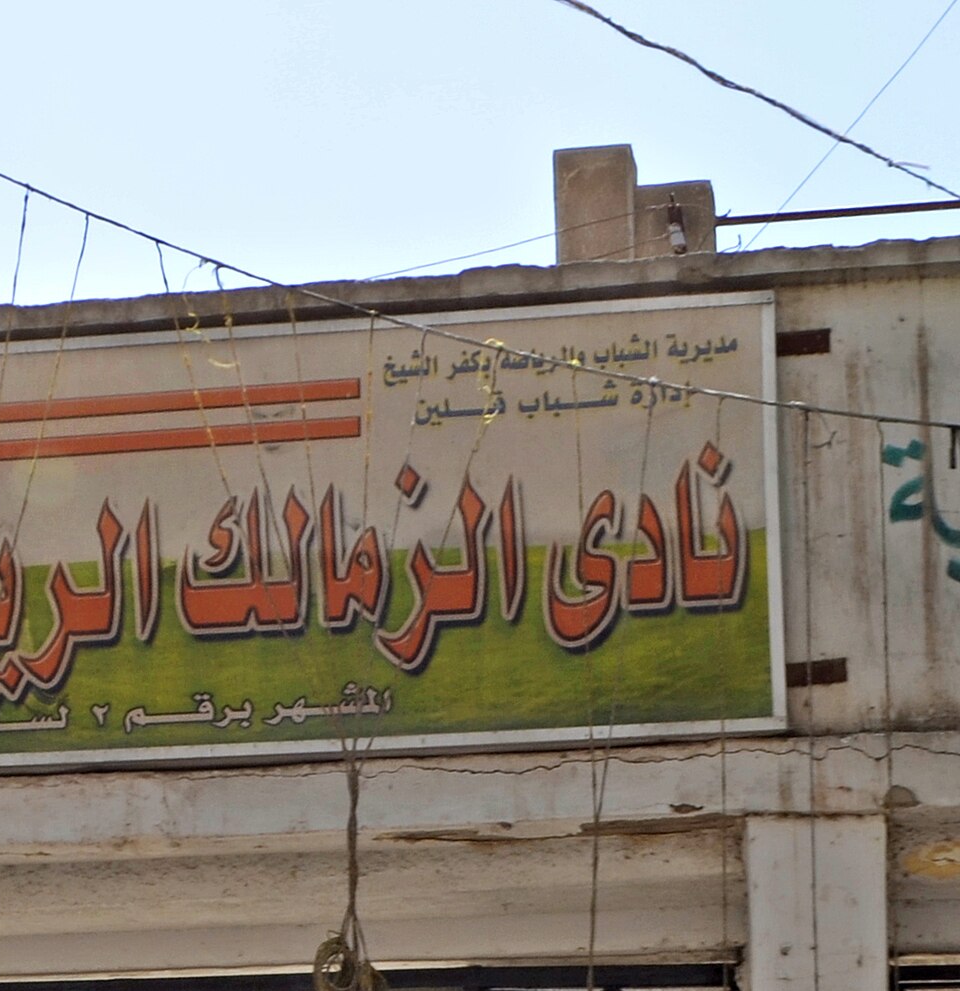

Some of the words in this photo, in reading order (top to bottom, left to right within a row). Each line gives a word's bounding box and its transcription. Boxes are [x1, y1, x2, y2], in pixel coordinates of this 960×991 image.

[383, 349, 438, 386] الشيخ
[594, 333, 658, 369] الشباب
[666, 333, 738, 364] مديرية
[518, 378, 618, 417] شباب
[177, 454, 524, 670] الزمالك
[124, 692, 253, 734] برقم
[263, 681, 392, 725] المشهر
